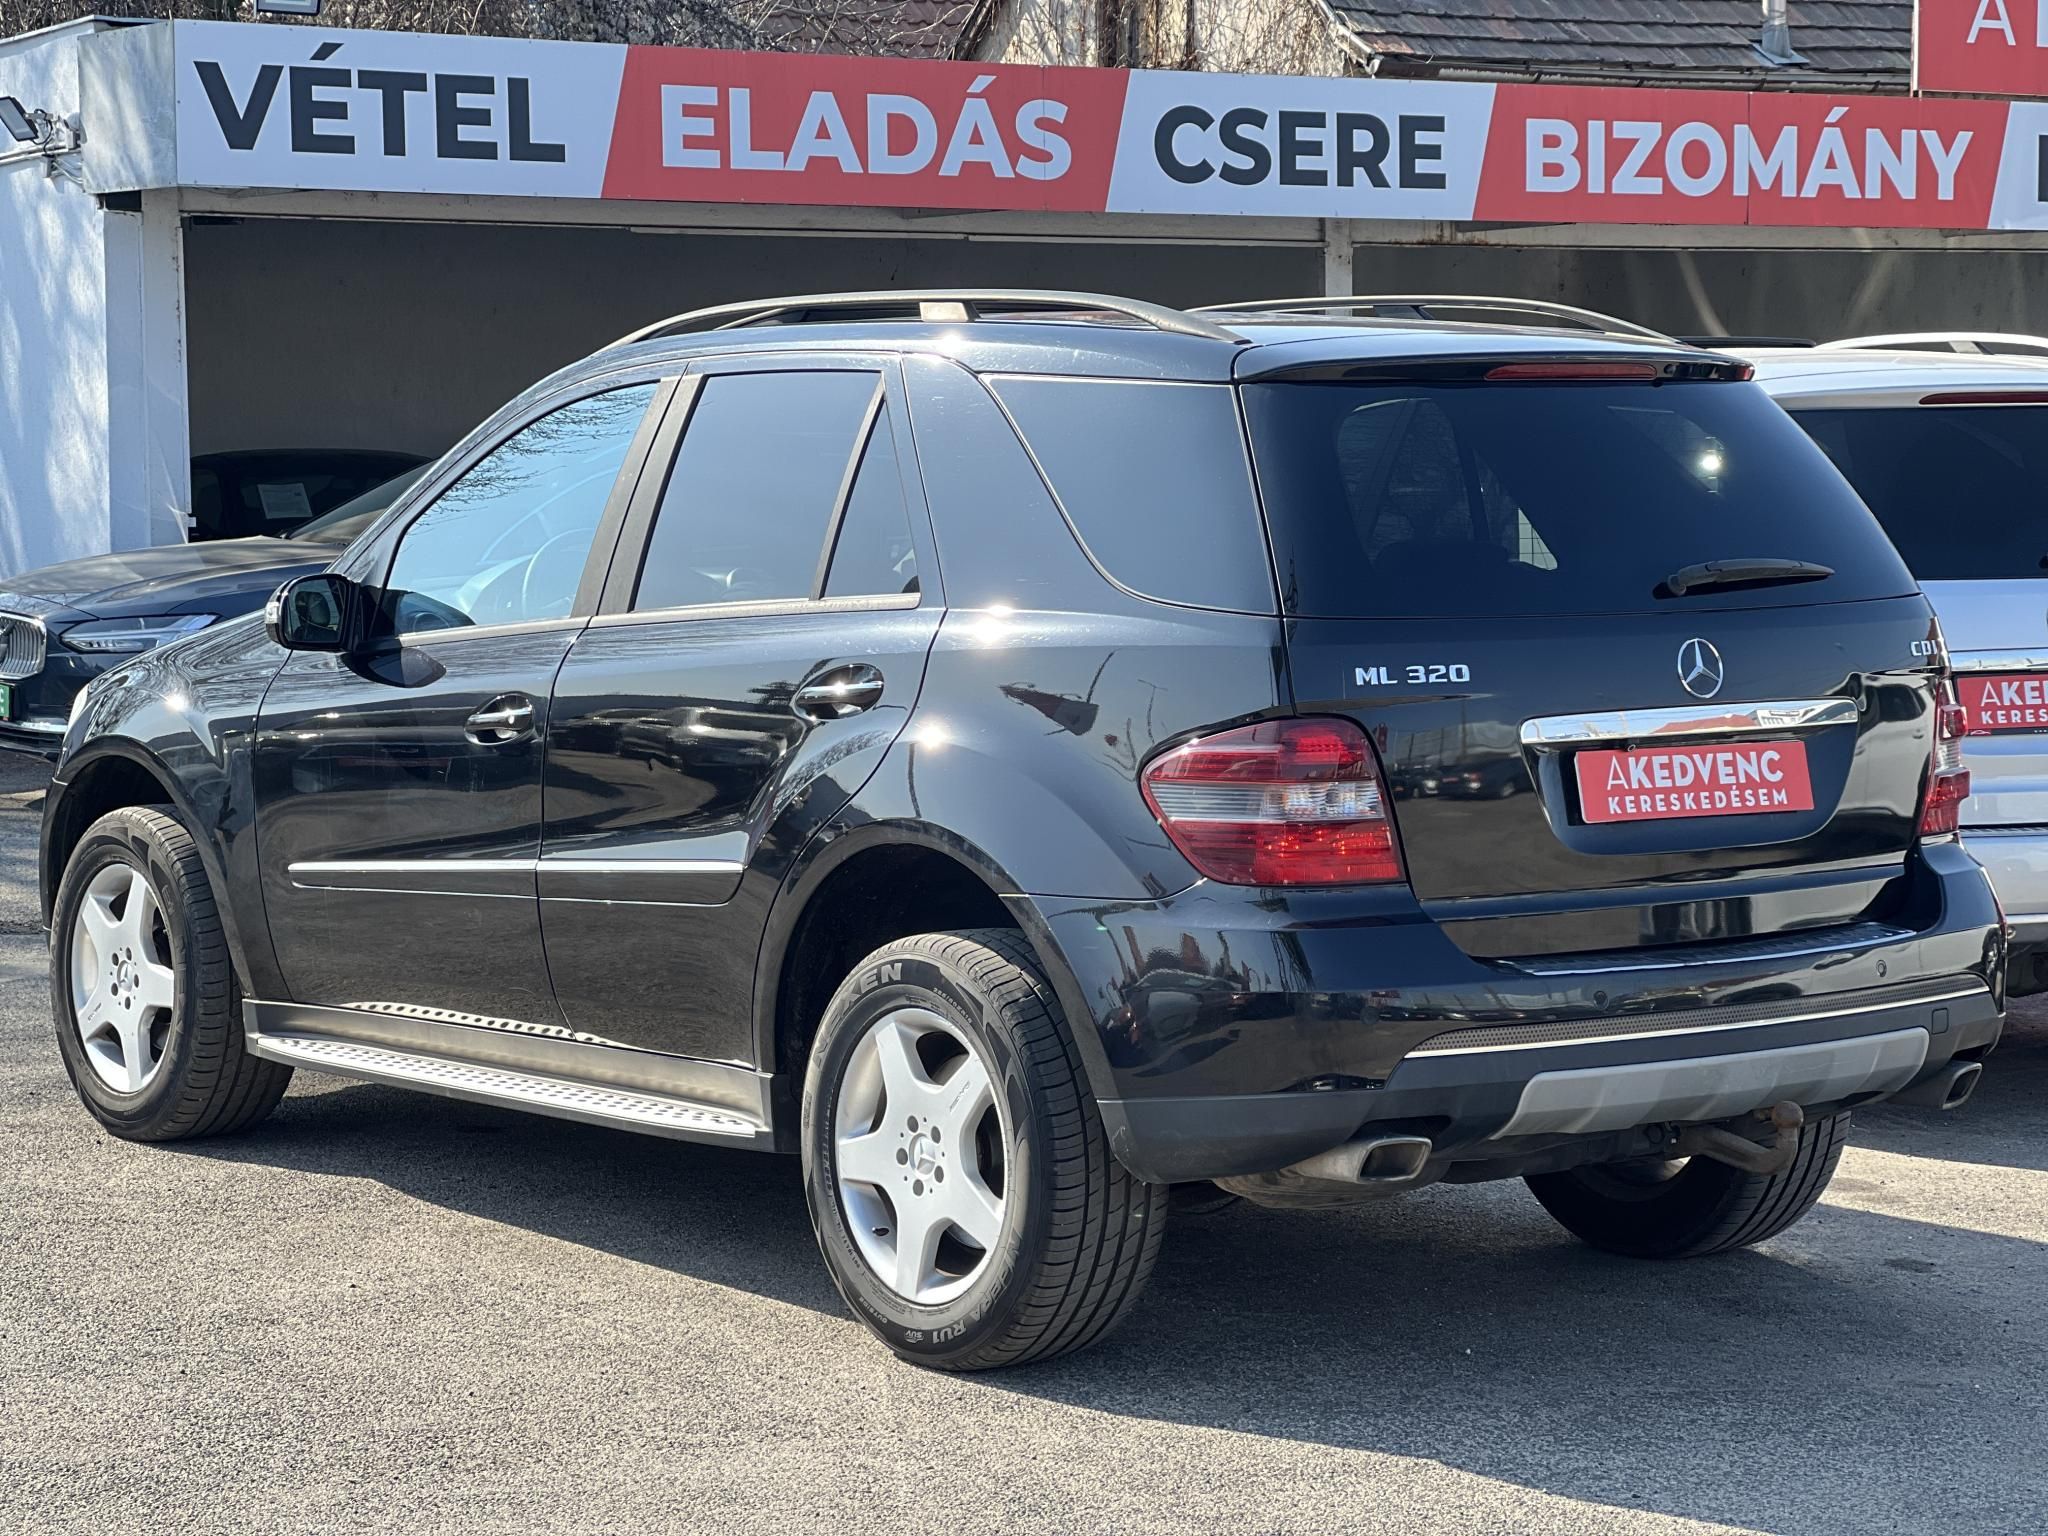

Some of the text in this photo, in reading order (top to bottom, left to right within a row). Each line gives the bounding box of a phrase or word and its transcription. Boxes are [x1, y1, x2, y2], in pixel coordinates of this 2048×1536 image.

[194, 42, 566, 163] VÉTEL
[660, 75, 1072, 180] ELADÁS
[1154, 105, 1446, 190] CSERE
[1525, 106, 1973, 201] BIZOMÁNY
[1910, 639, 1938, 656] CDI
[1355, 664, 1470, 685] ML 320
[1607, 750, 1784, 790] AKEDVENC
[1608, 786, 1788, 814] KERESKEDÉSEM
[932, 1319, 967, 1344] RU1
